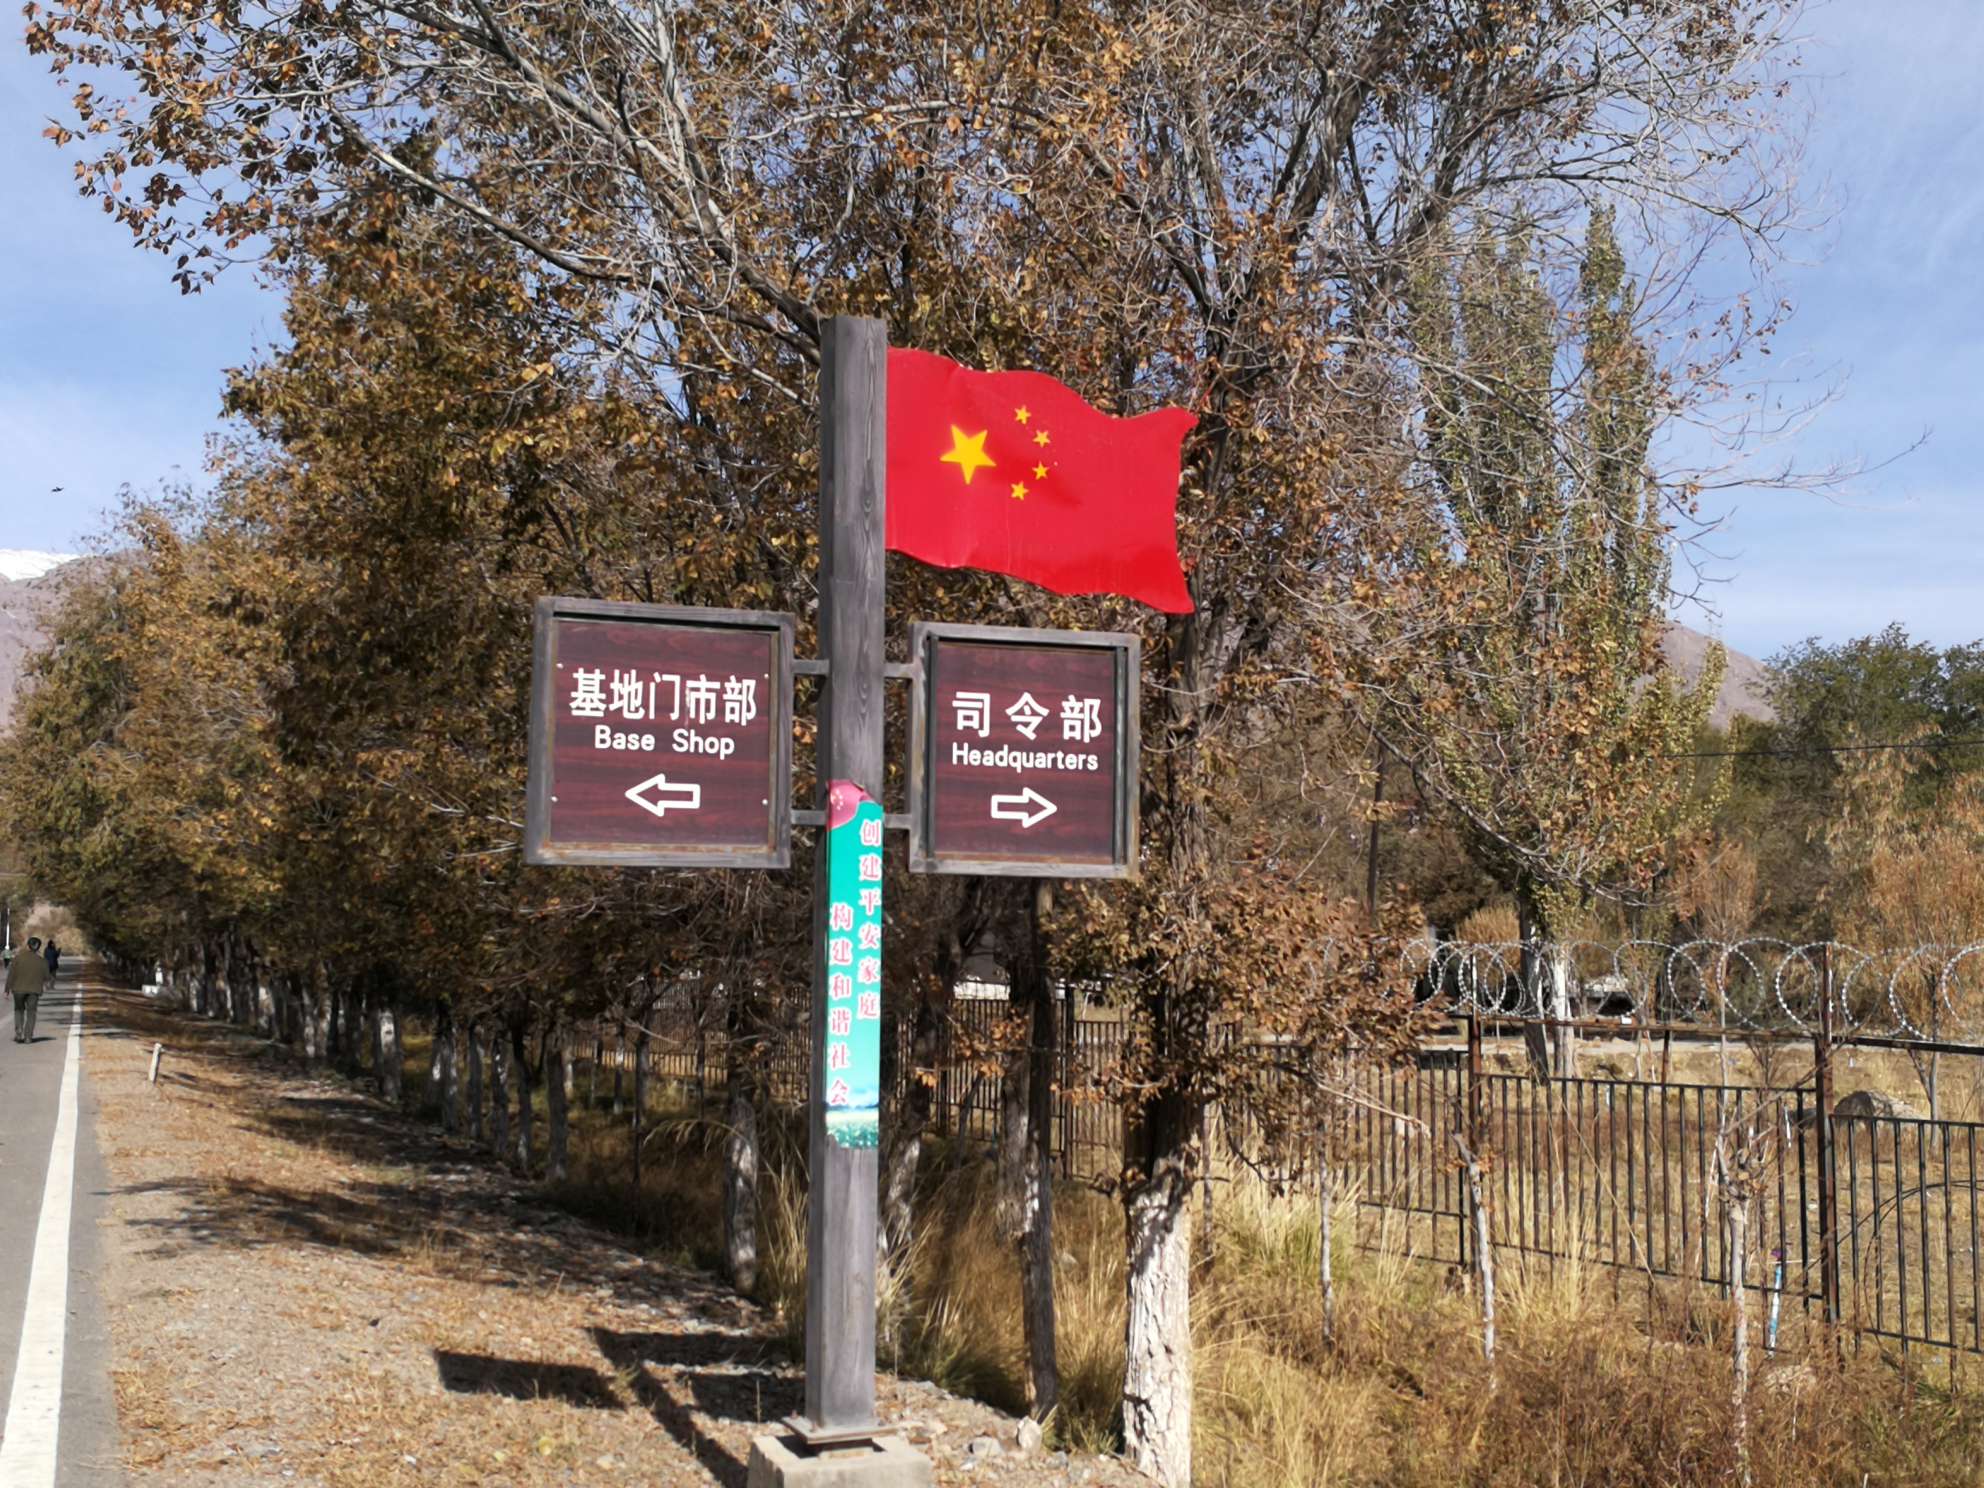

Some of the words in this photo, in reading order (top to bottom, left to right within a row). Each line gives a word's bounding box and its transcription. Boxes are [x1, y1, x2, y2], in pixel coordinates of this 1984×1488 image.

[569, 668, 757, 726] 基地门市部
[952, 692, 1102, 743] 司令部
[594, 725, 655, 751] Base
[672, 729, 735, 760] Shop
[952, 742, 1099, 773] Headquarters
[858, 819, 882, 1019] 创建平安家庭
[829, 902, 853, 1105] 构建和谐社会
